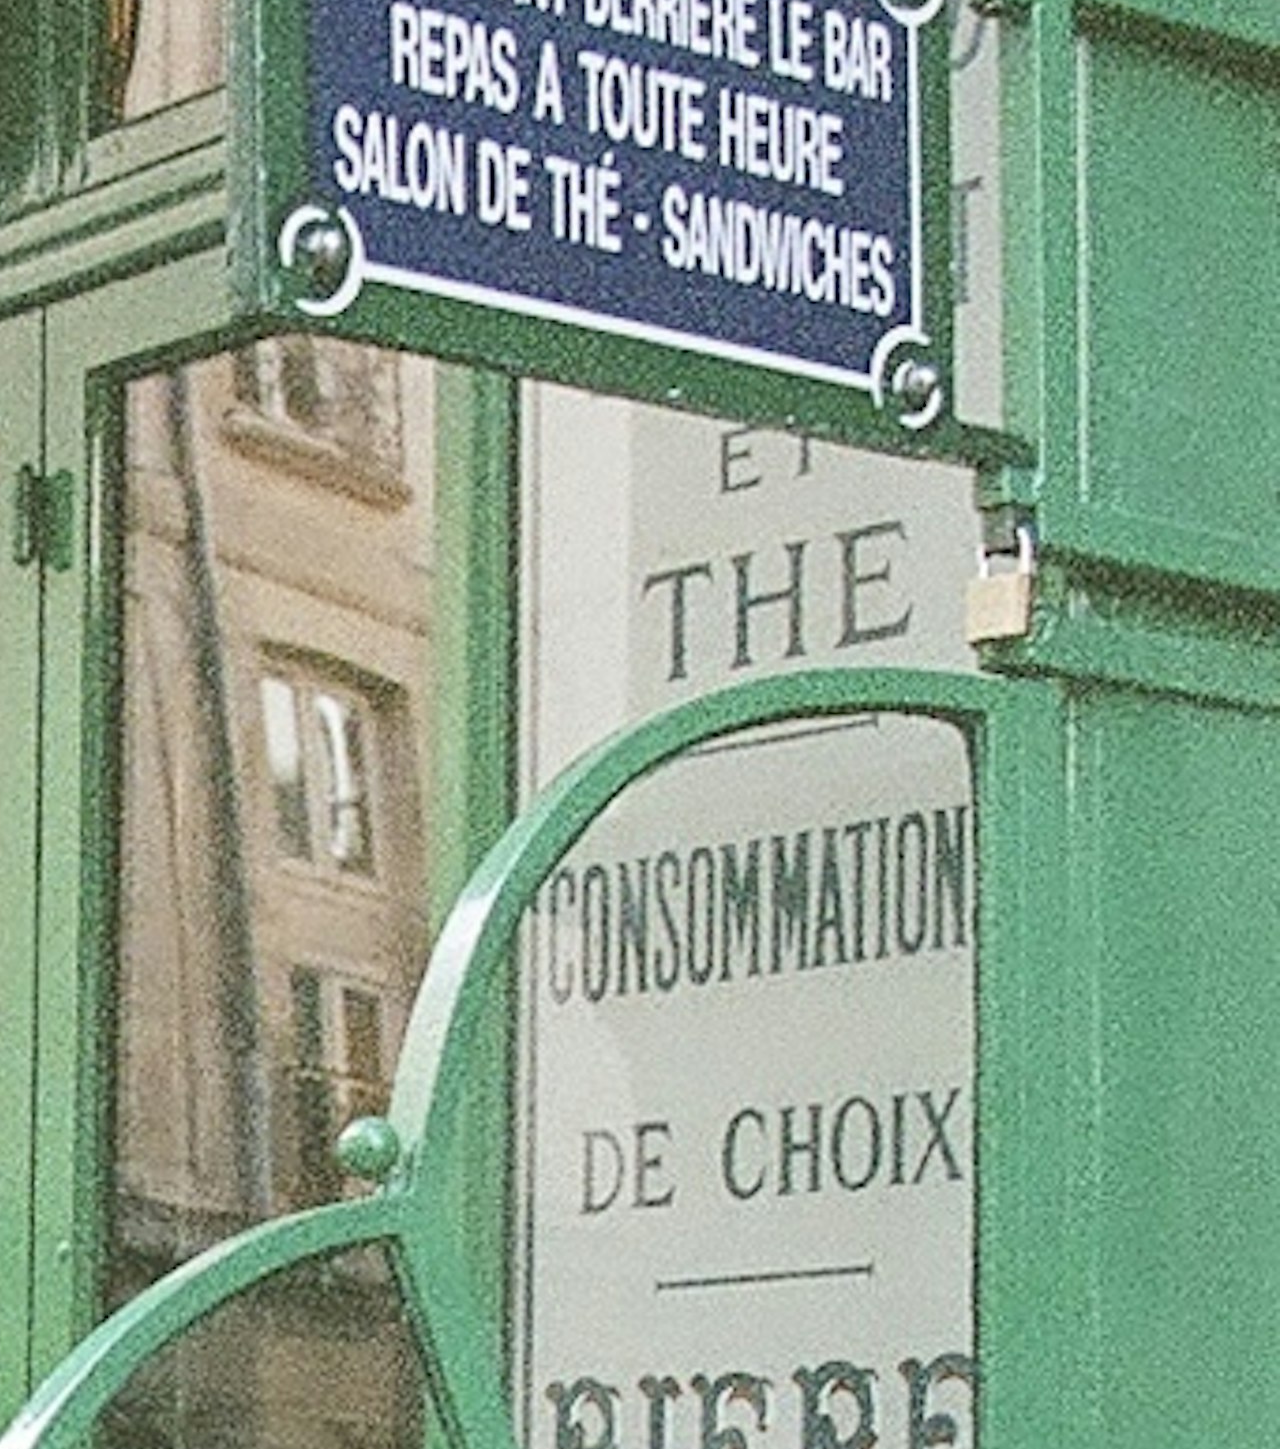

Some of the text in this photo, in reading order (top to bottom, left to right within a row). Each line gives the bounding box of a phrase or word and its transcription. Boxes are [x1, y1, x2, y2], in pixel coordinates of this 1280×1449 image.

[389, 1, 844, 198] REPAS A TOUTE HEURE
[822, 4, 894, 103] BAR
[332, 102, 466, 218] SALON
[476, 146, 533, 233] DE
[542, 150, 624, 255] THÉ
[660, 182, 896, 319] SANDWICHES
[643, 519, 912, 683] THE
[577, 1085, 963, 1216] DE CHOIX
